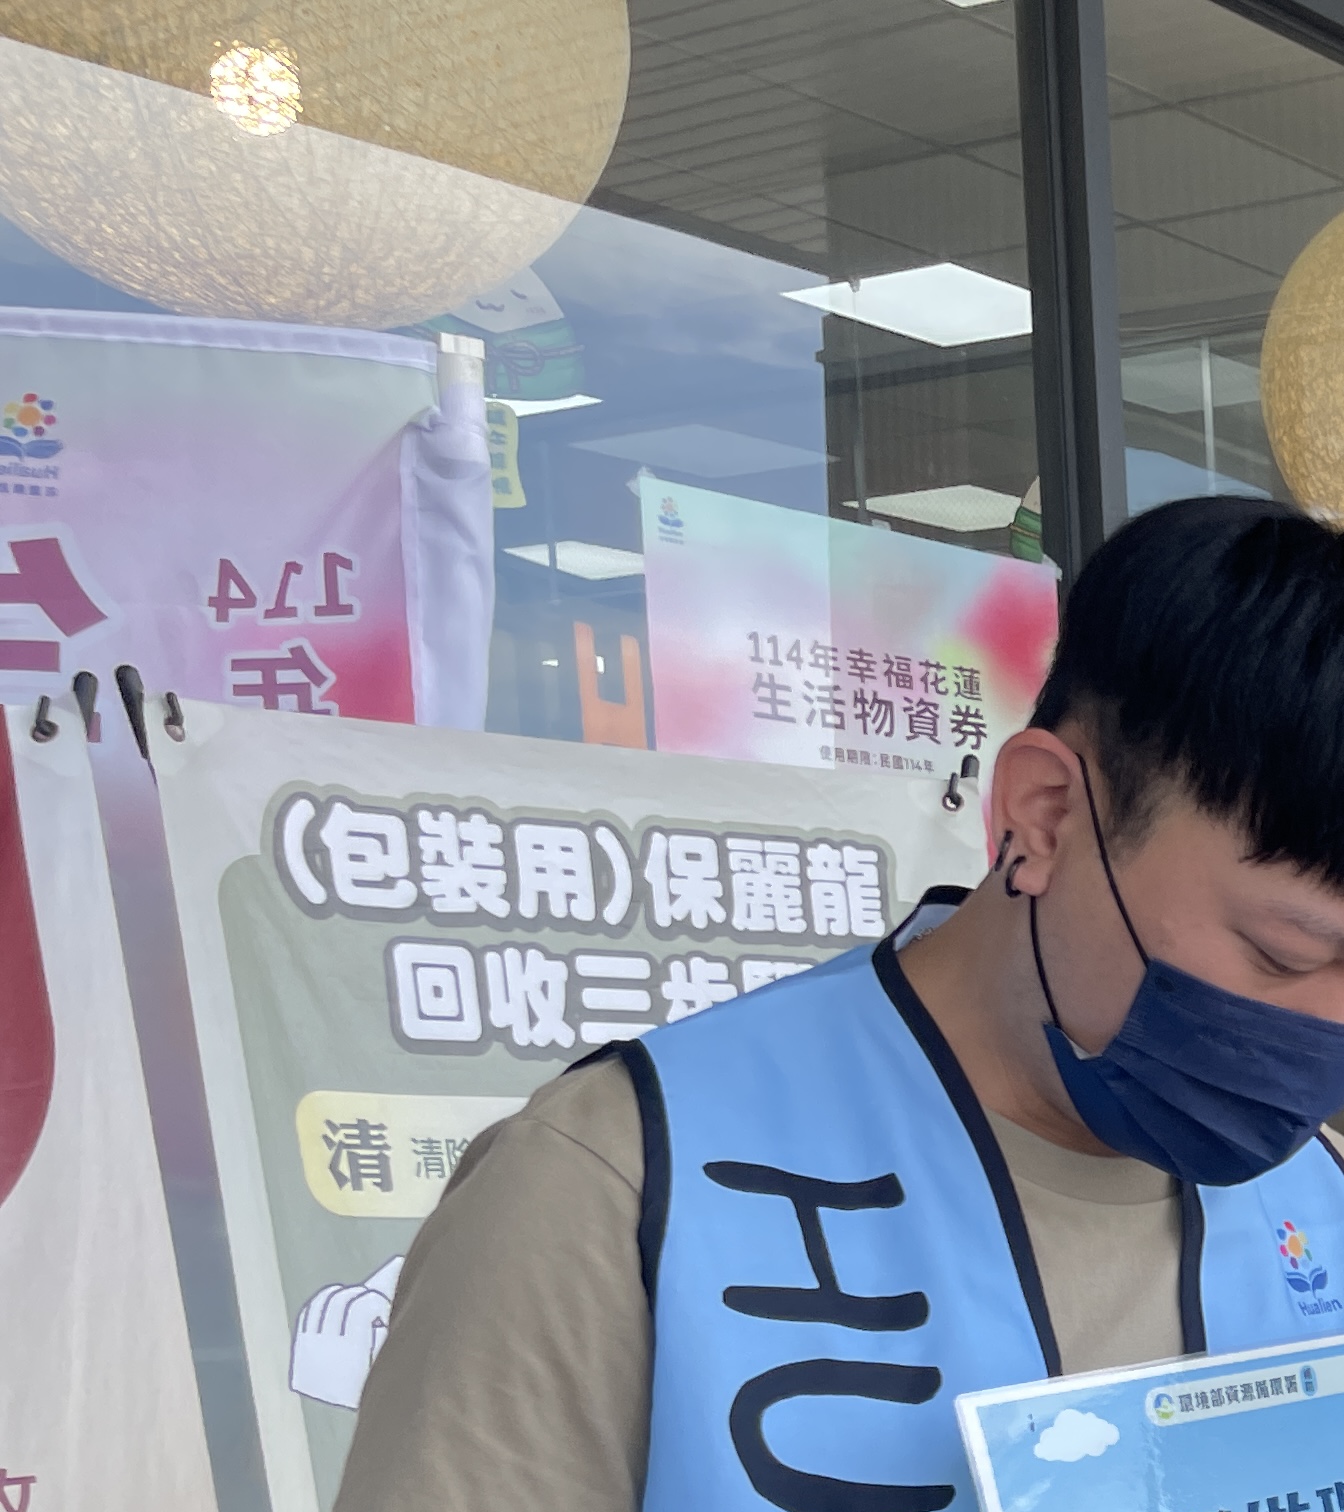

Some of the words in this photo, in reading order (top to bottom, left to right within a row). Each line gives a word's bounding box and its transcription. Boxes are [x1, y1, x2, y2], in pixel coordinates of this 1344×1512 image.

[747, 631, 983, 702] 114年幸福花蓮
[752, 672, 987, 750] 生活物資券
[283, 799, 885, 936] (包裝用)保麗龍
[322, 1119, 393, 1193] 清
[1298, 1298, 1343, 1316] Hualien
